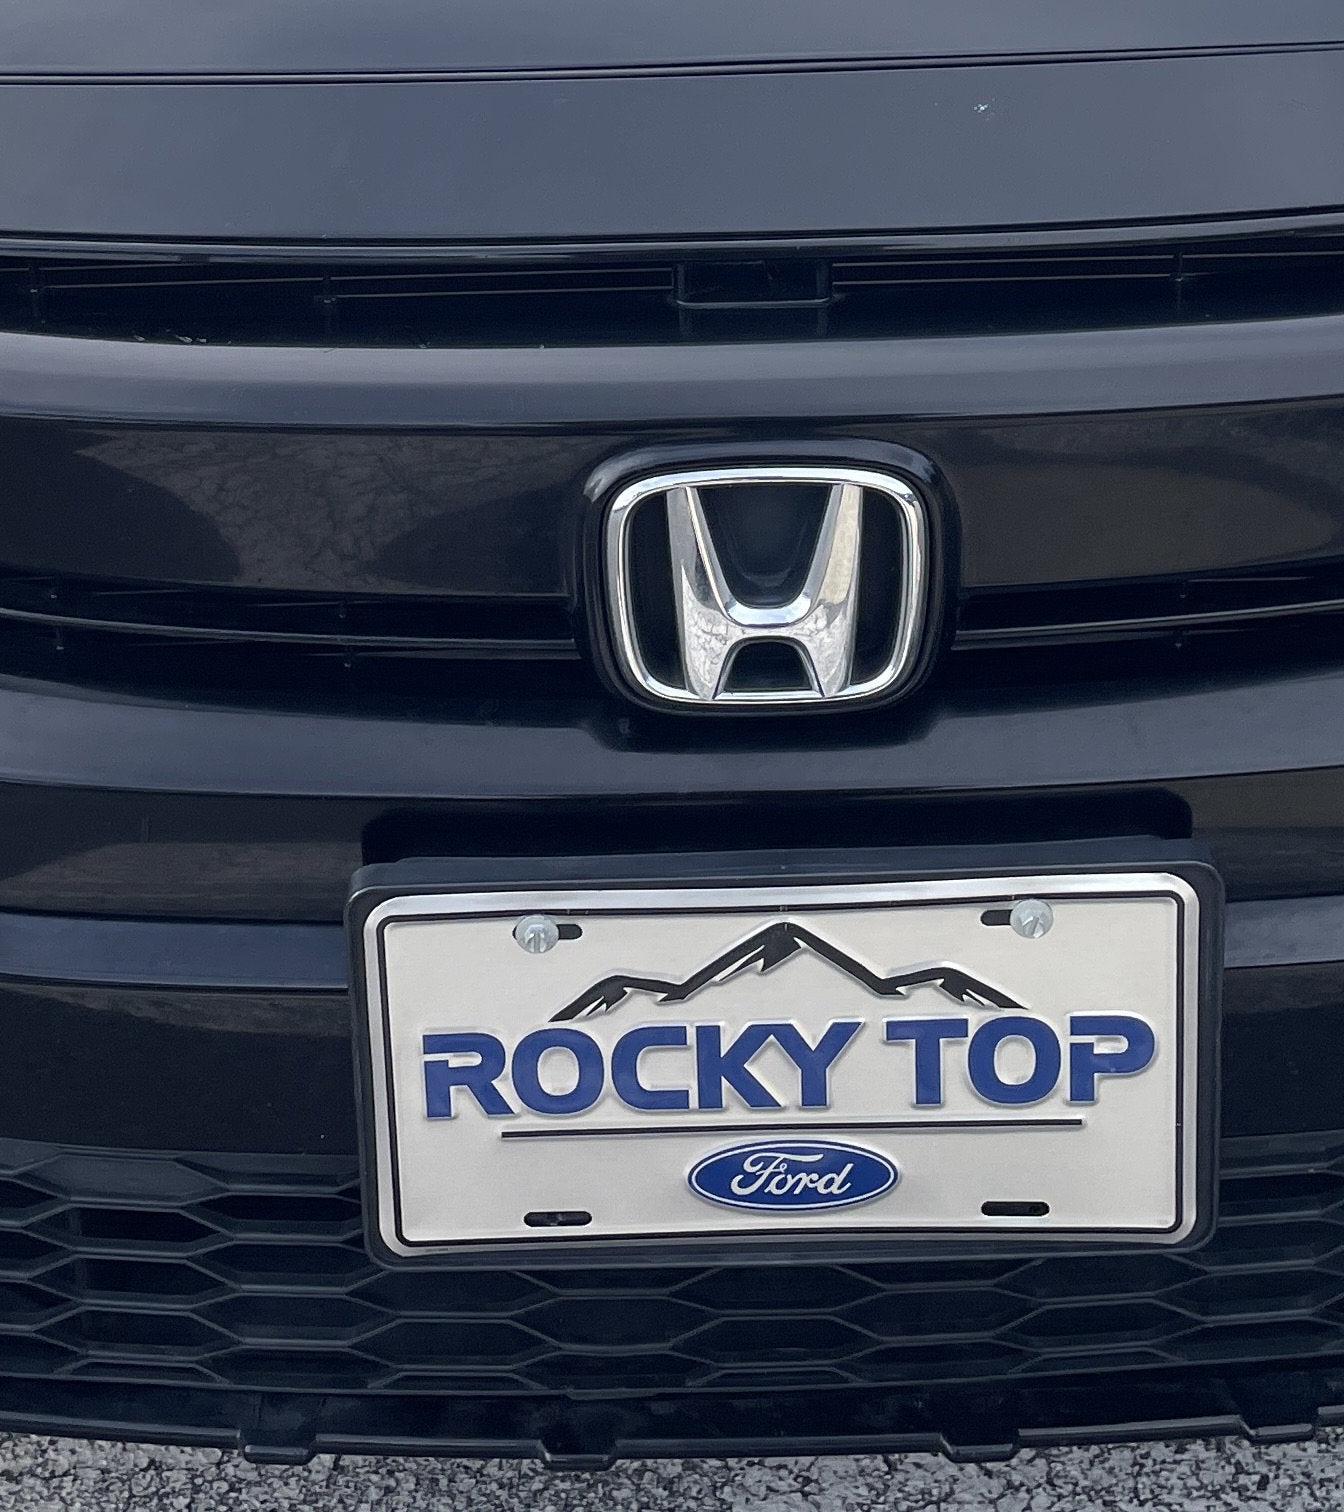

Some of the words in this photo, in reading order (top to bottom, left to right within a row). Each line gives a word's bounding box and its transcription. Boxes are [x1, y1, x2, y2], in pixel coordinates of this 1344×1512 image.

[422, 1021, 867, 1120] ROCKY
[886, 1014, 1157, 1107] TOP
[730, 1151, 854, 1196] Ford
